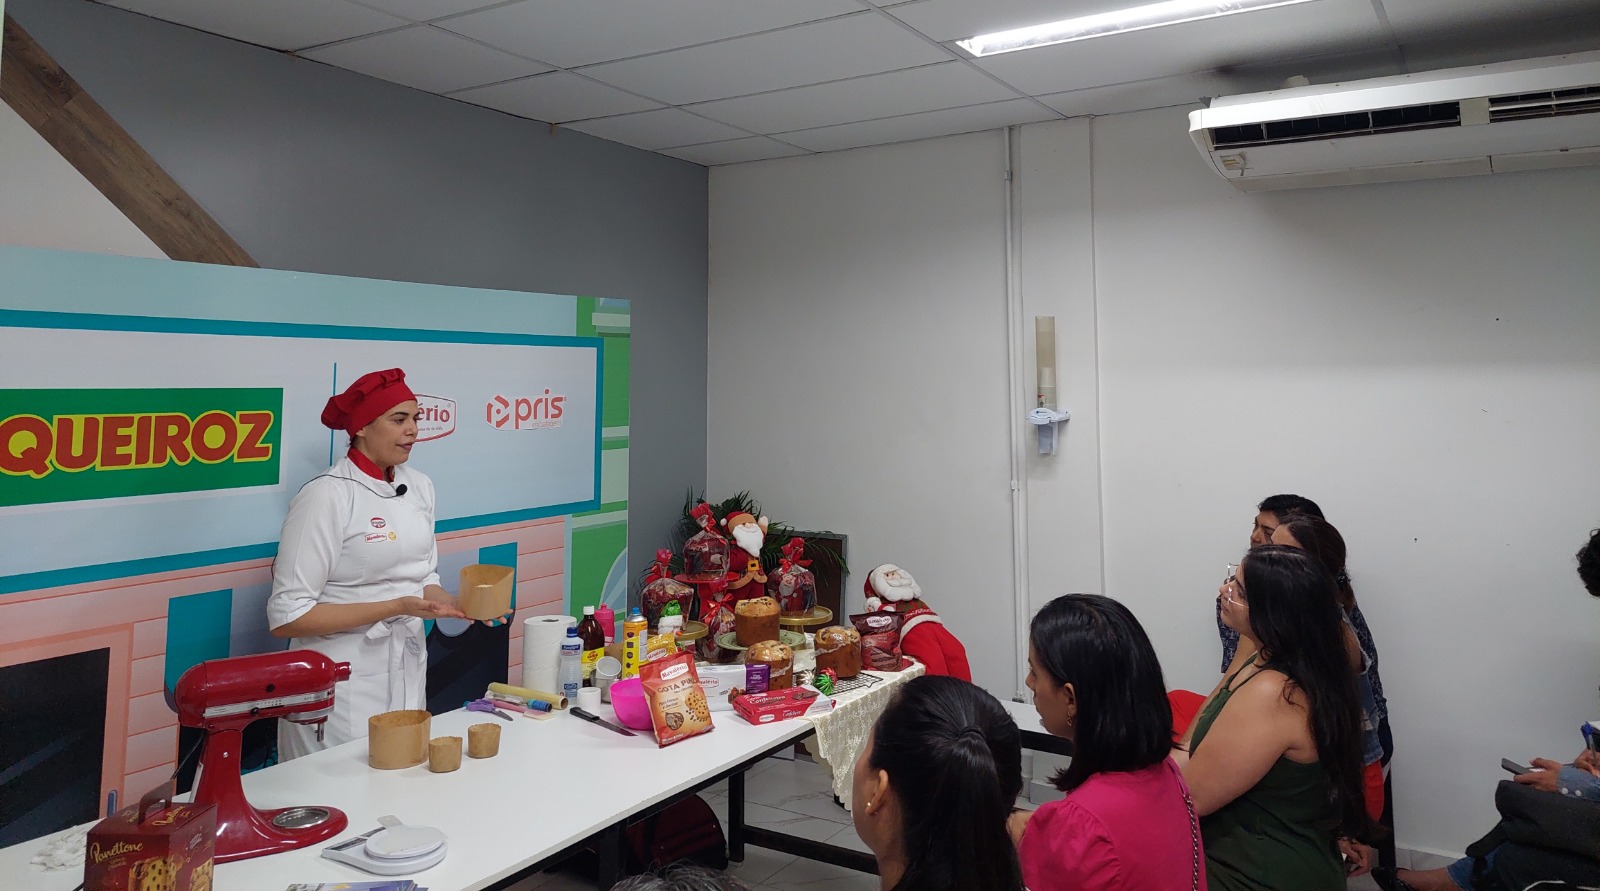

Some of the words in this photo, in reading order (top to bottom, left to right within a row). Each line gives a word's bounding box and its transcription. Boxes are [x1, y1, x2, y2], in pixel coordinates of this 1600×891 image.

[515, 389, 564, 429] pris
[0, 410, 273, 479] QUEIROZ
[661, 664, 688, 678] Mavalério
[657, 683, 680, 693] GOTA
[90, 841, 144, 864] Panettone
